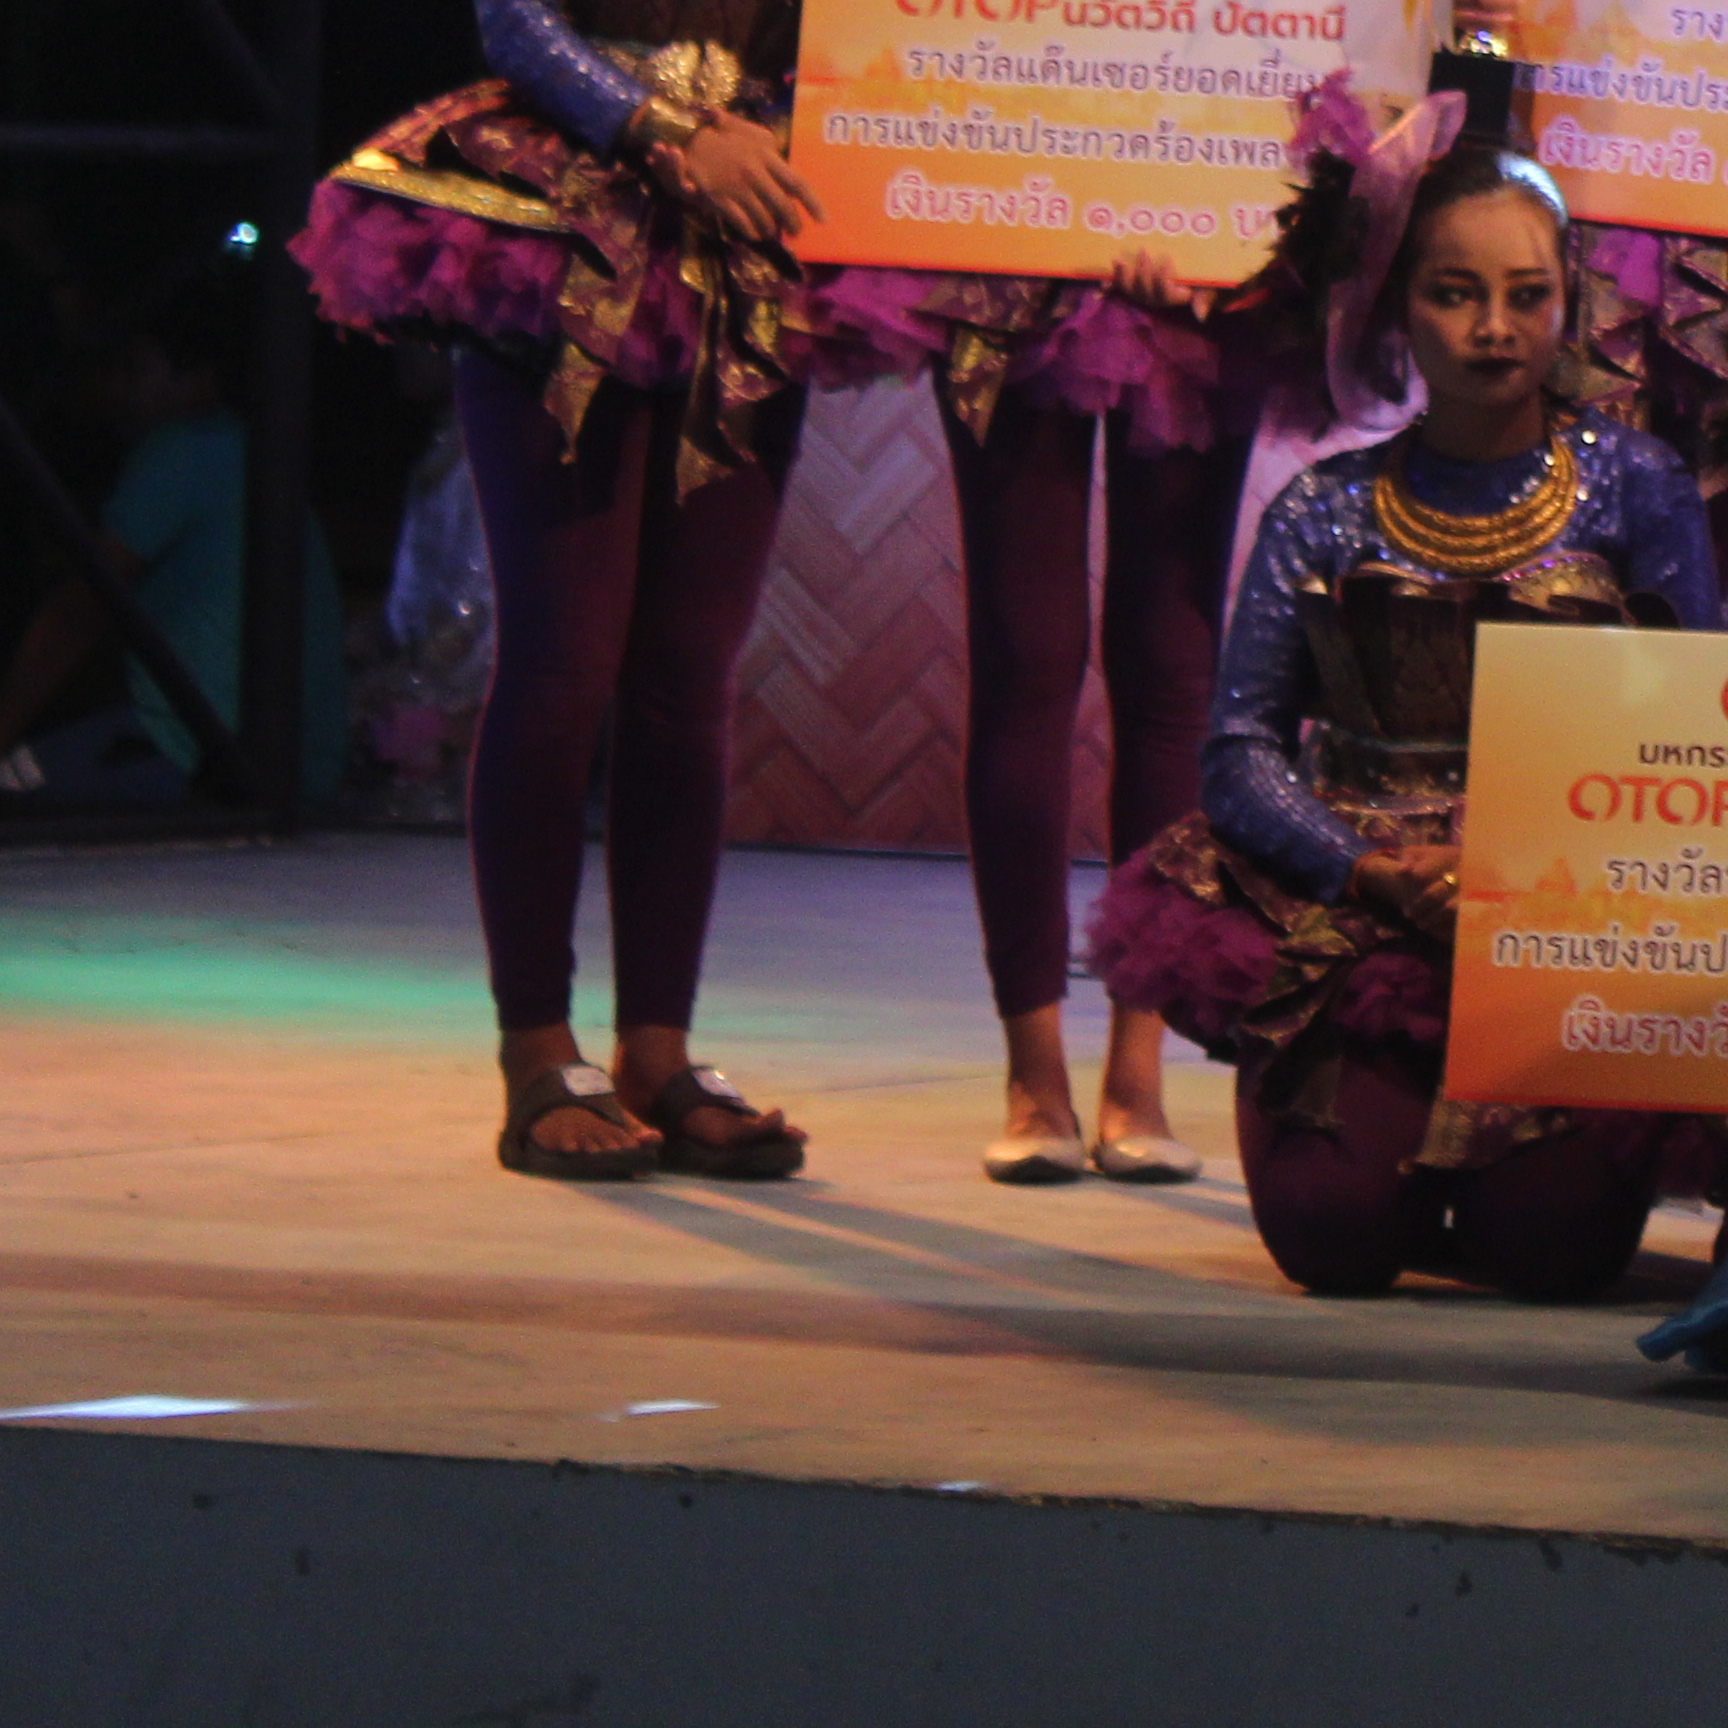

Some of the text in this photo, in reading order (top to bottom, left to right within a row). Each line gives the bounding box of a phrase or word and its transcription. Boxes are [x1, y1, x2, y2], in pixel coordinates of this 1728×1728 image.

[1213, 2, 1346, 42] ปัตตานี
[829, 105, 1280, 168] การแข่งขันประกวดร้องเพล
[1543, 121, 1712, 182] เงินรางวัล
[892, 175, 1069, 229] เงินรางวัล
